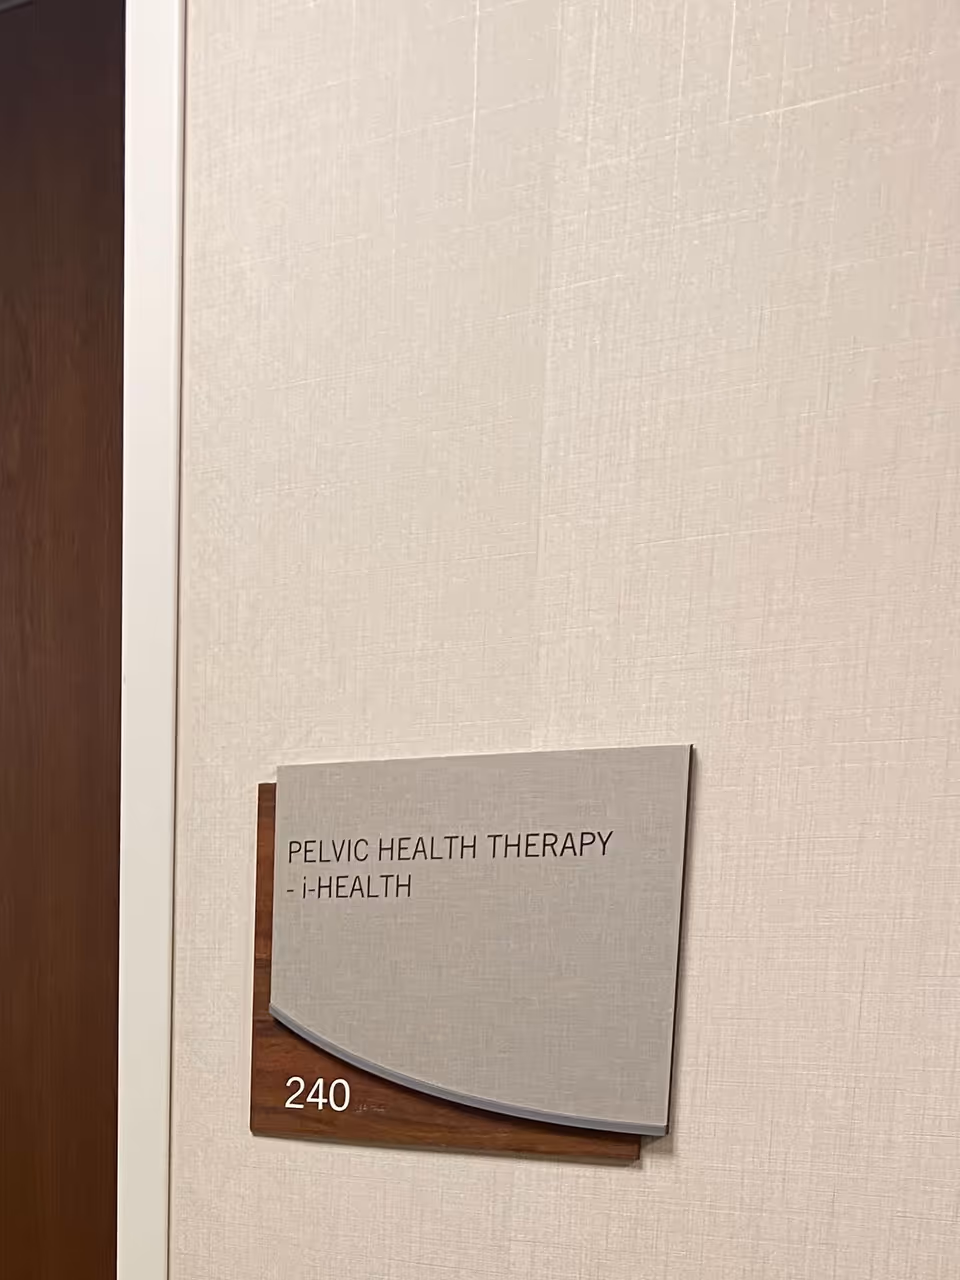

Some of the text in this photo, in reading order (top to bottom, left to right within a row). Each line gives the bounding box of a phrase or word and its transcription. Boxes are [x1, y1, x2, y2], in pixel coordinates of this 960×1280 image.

[288, 830, 614, 863] PELVIC HEALTH THERAPY
[302, 874, 412, 899] i-HEALTH
[284, 1076, 351, 1111] 240
